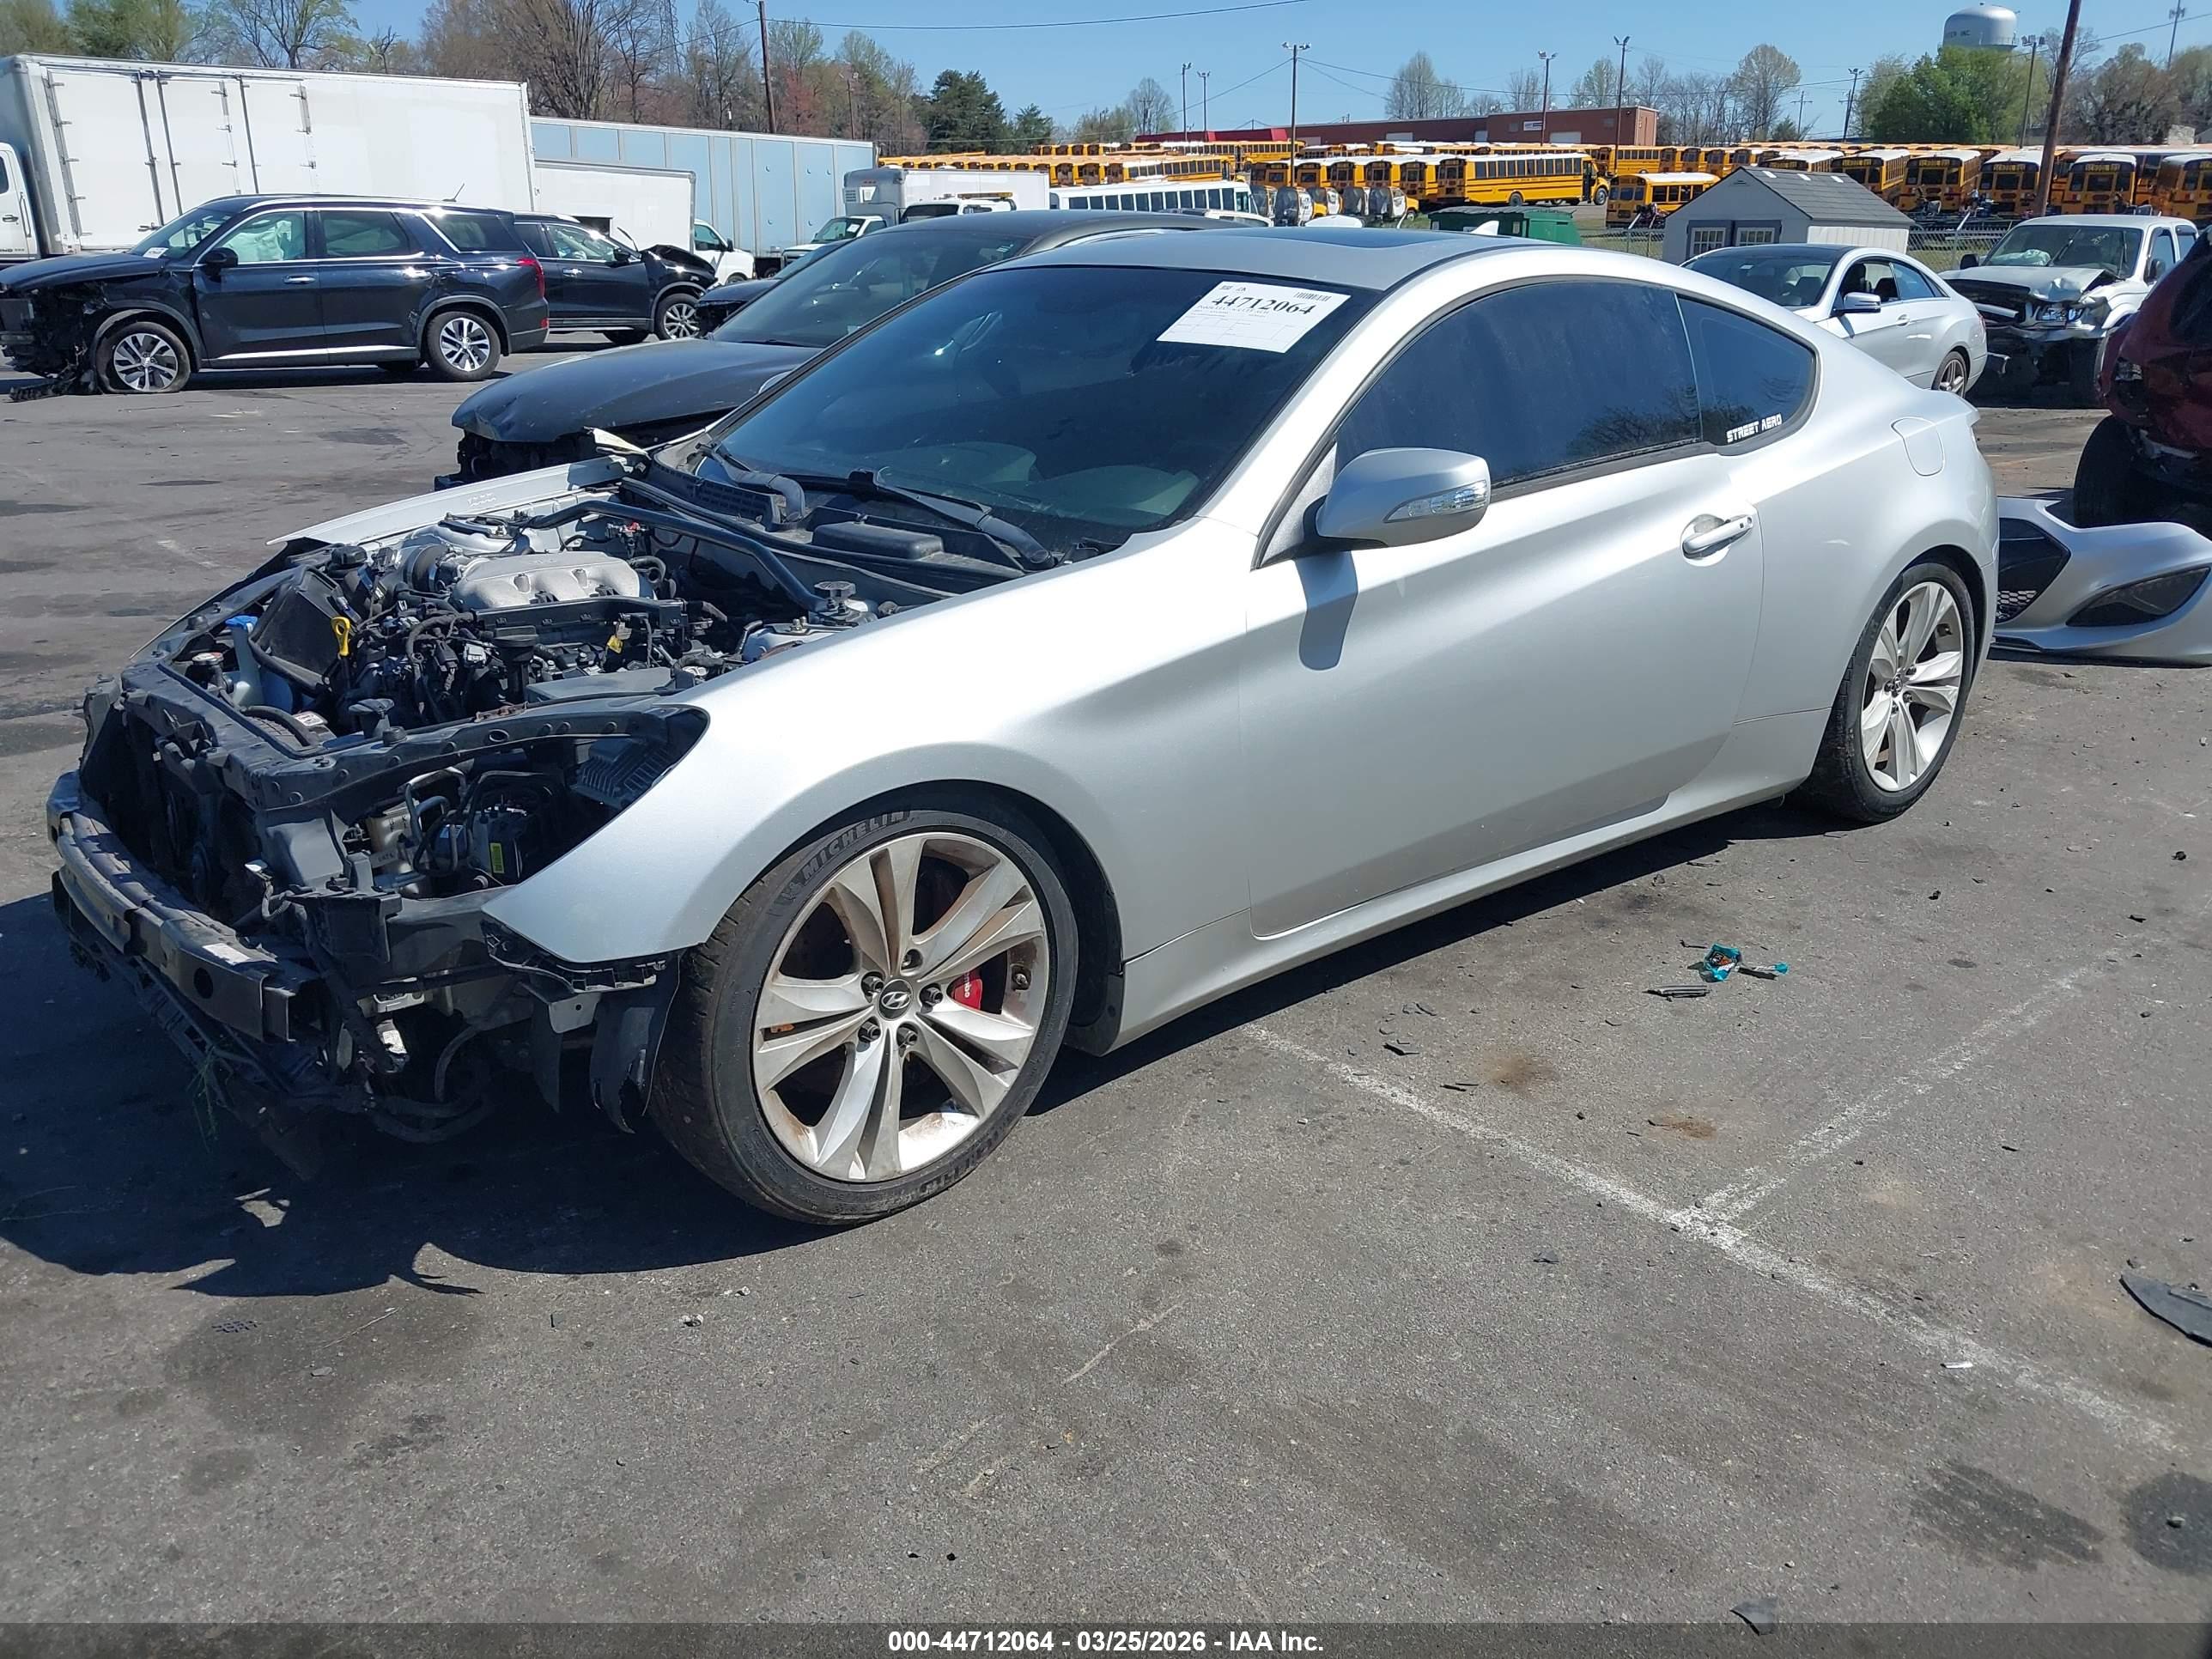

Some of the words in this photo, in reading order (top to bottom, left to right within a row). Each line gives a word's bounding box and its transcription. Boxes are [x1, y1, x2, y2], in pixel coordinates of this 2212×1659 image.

[1212, 295, 1318, 315] 44712064
[1726, 420, 1759, 443] STREET
[1761, 413, 1783, 431] AERO
[801, 811, 904, 881] MICHELIN
